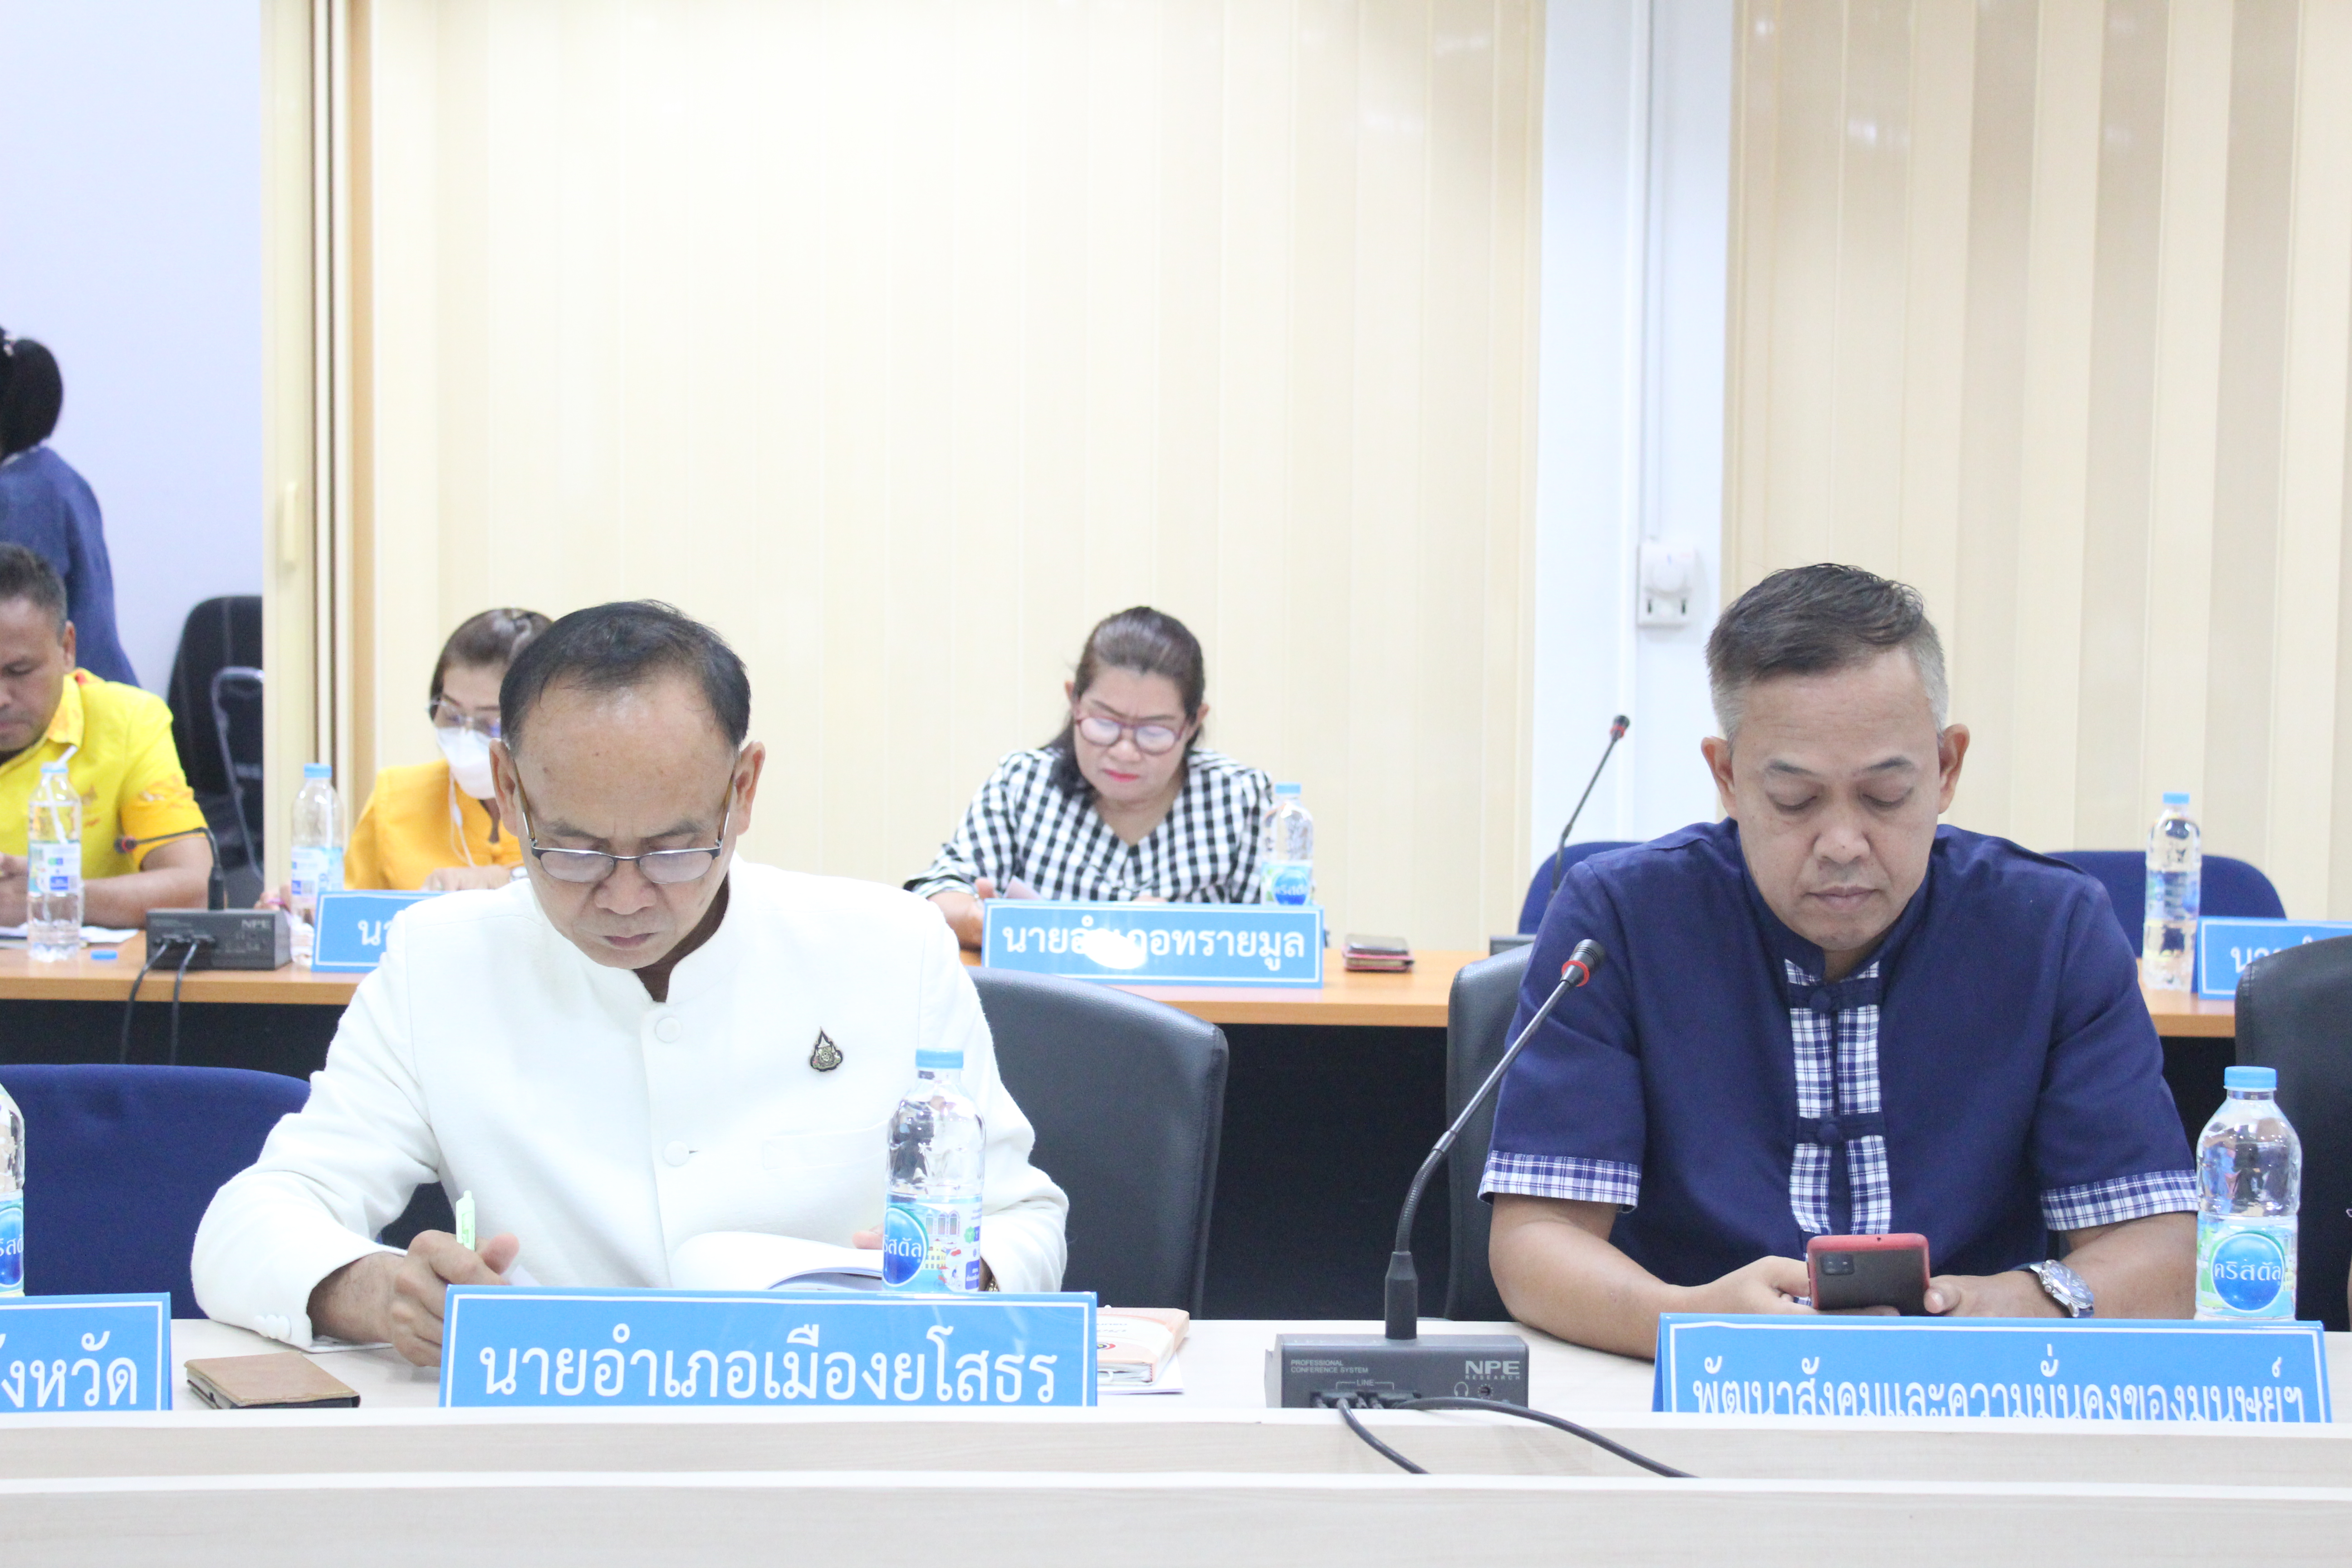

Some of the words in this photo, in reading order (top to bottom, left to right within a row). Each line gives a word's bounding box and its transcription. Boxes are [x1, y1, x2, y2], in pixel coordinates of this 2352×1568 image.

[2214, 1261, 2282, 1281] คริสตัล
[0, 1331, 137, 1408] งหวัด
[480, 1323, 1058, 1403] นายอำเภอเมืองยโสธร
[1465, 1360, 1520, 1375] NPE
[1693, 1343, 2304, 1423] พัฒนาสังคมและความมั่นคงของมนษย์ฯ
